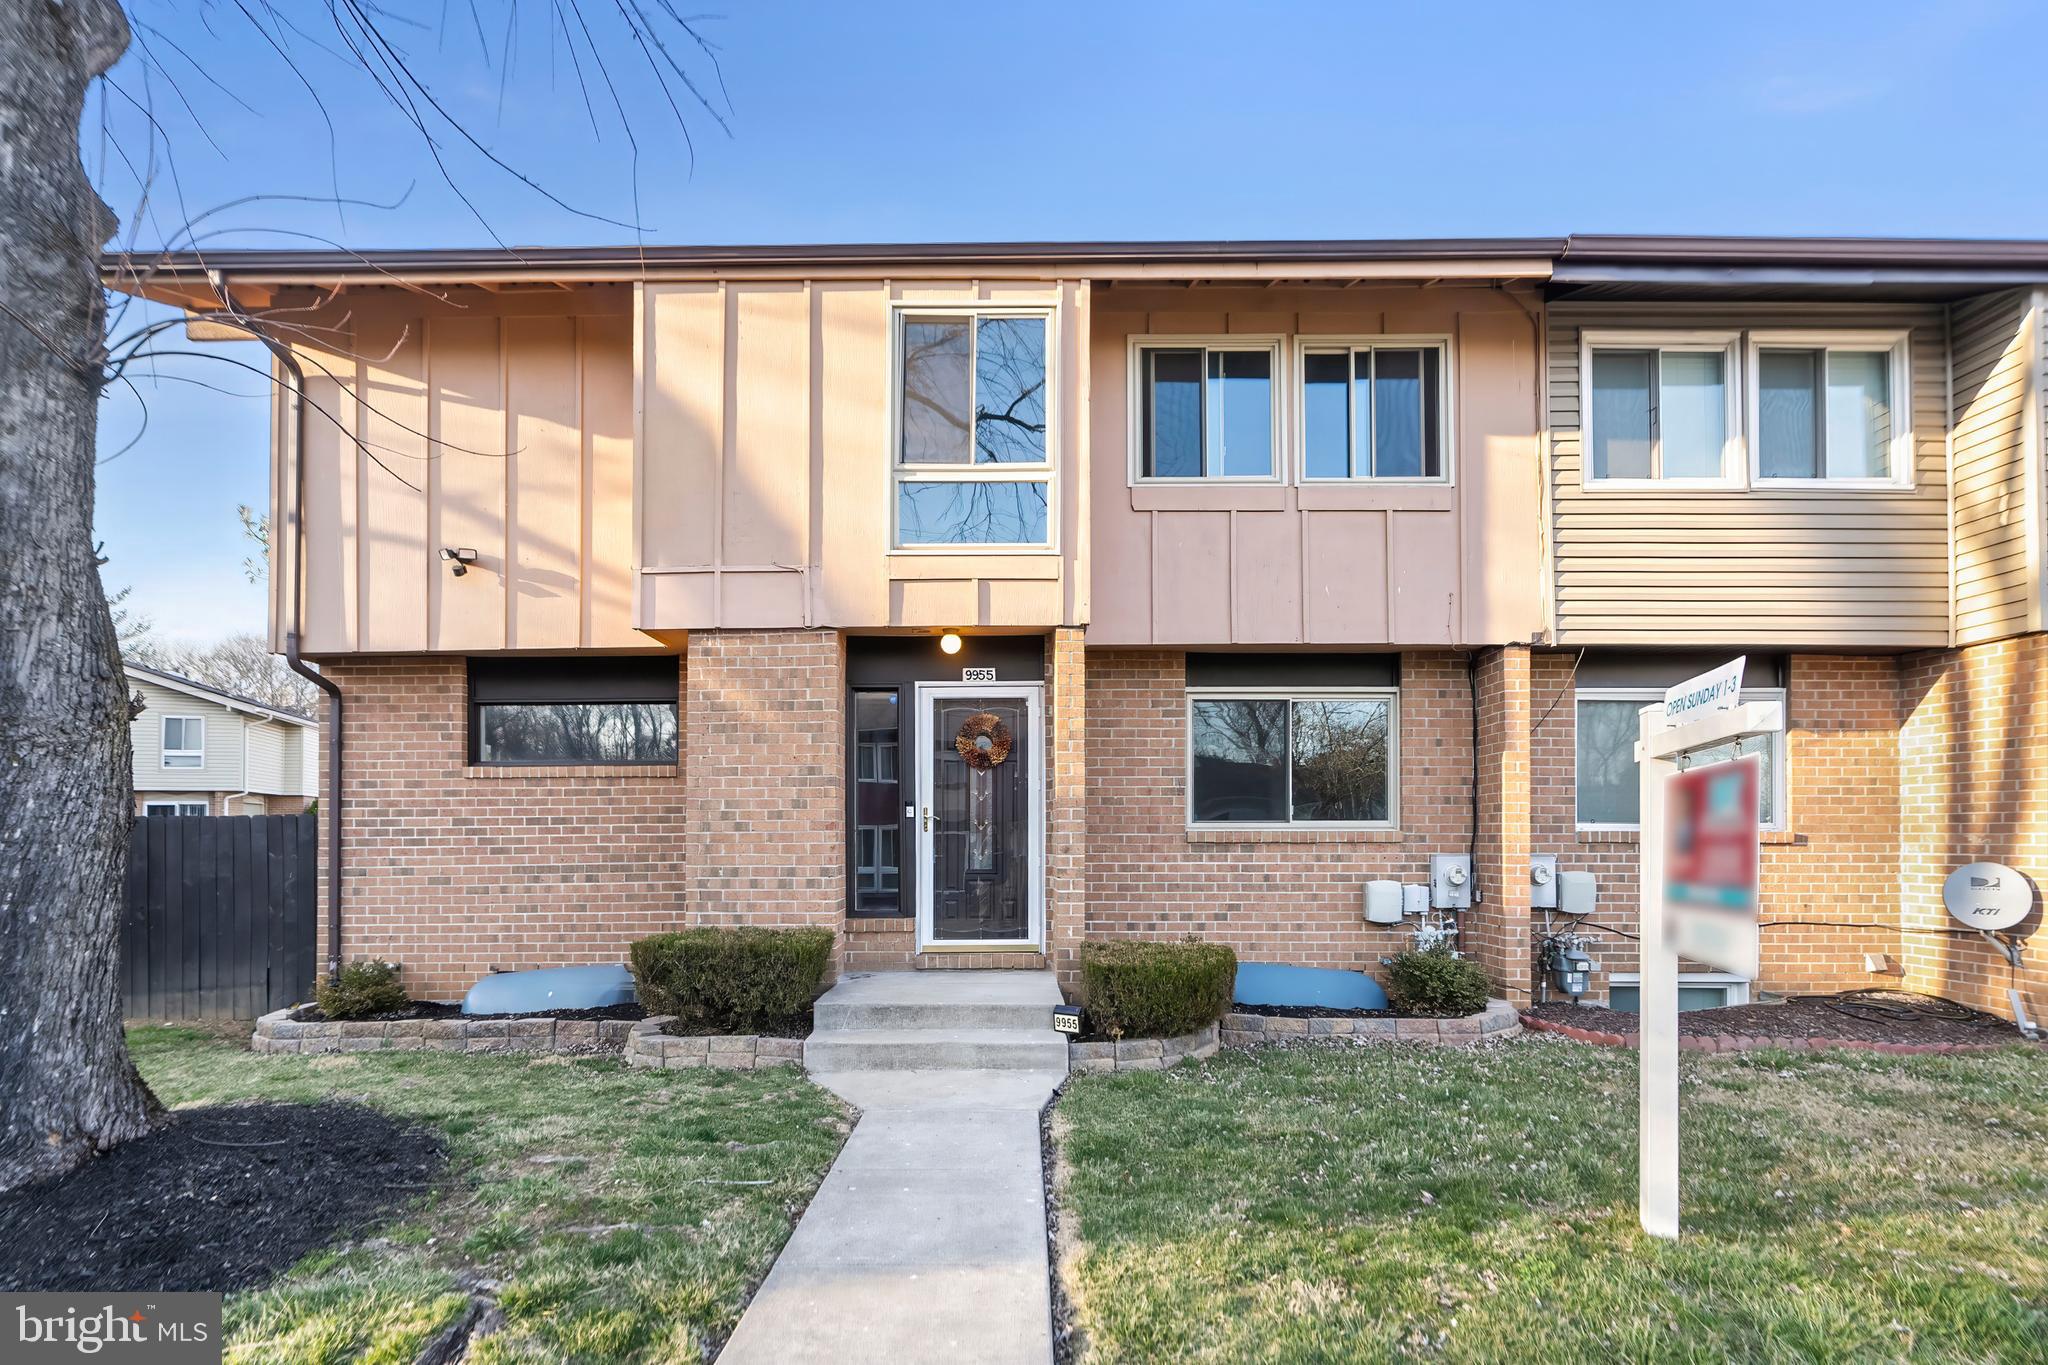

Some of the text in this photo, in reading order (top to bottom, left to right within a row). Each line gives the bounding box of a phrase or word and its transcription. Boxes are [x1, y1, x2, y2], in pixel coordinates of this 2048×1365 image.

[965, 670, 993, 680] 9955
[1667, 676, 1737, 716] OPEN SUNDAY 1-3
[1056, 1017, 1077, 1030] 9955
